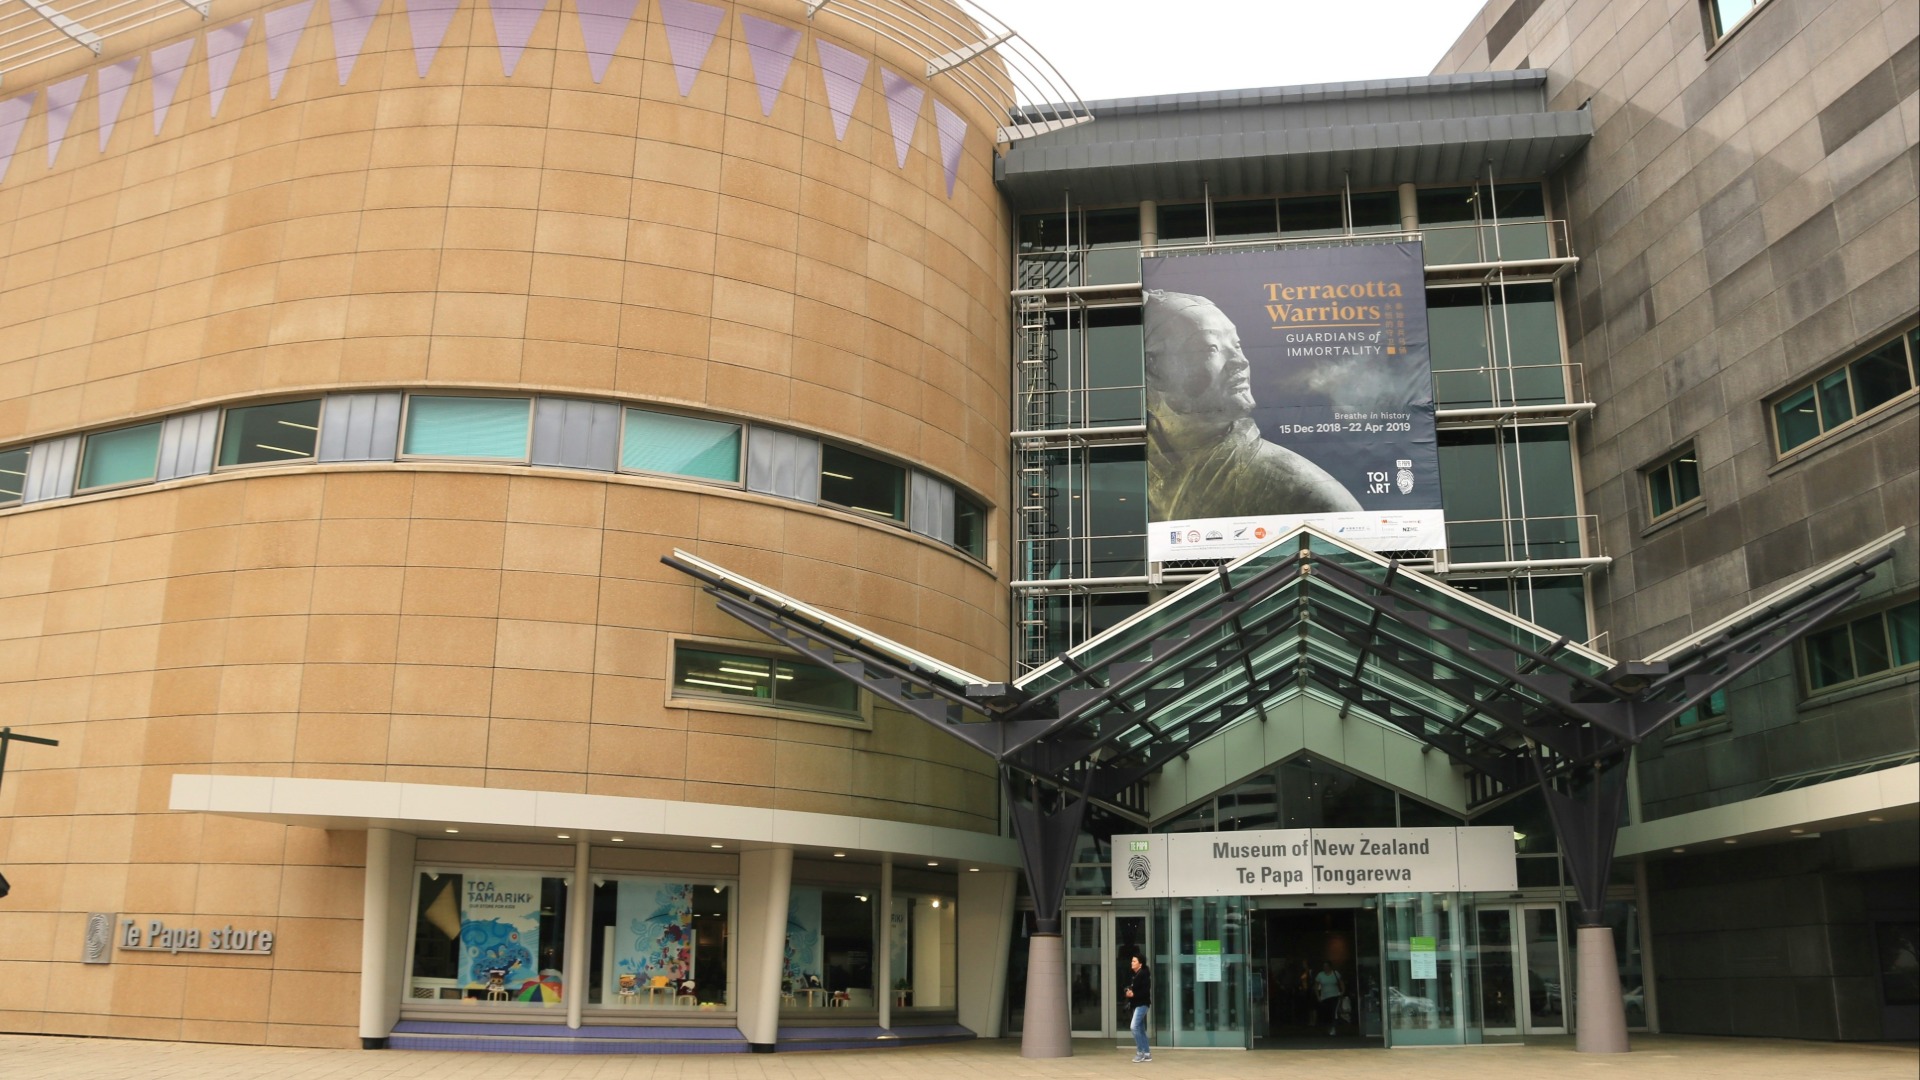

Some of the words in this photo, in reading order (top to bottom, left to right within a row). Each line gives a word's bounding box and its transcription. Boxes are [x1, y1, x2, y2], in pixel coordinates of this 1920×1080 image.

[1263, 281, 1403, 301] Terracotta
[1264, 301, 1381, 322] Warriors
[1285, 332, 1365, 343] GUARDIANS
[1368, 331, 1381, 344] of
[1287, 346, 1381, 357] IMMORTALITY
[1334, 412, 1367, 420] Breathe
[1381, 411, 1411, 421] history
[1279, 425, 1291, 434] 15
[1293, 424, 1314, 433] Dec
[1364, 423, 1384, 434] Apr
[1386, 422, 1411, 432] 2019
[1367, 472, 1388, 483] TOI
[1130, 842, 1136, 850] TE
[1136, 841, 1148, 850] PAPA
[1213, 842, 1286, 858] Museum
[1292, 839, 1309, 857] of
[1313, 839, 1355, 856] New
[1360, 838, 1430, 856] Zealand
[1236, 867, 1255, 884] Te
[1261, 866, 1303, 887] Papa
[1313, 865, 1412, 886] Tongarewa
[467, 881, 495, 892] TOA
[121, 919, 141, 946] Te
[147, 919, 200, 955] Papa
[208, 924, 273, 951] store
